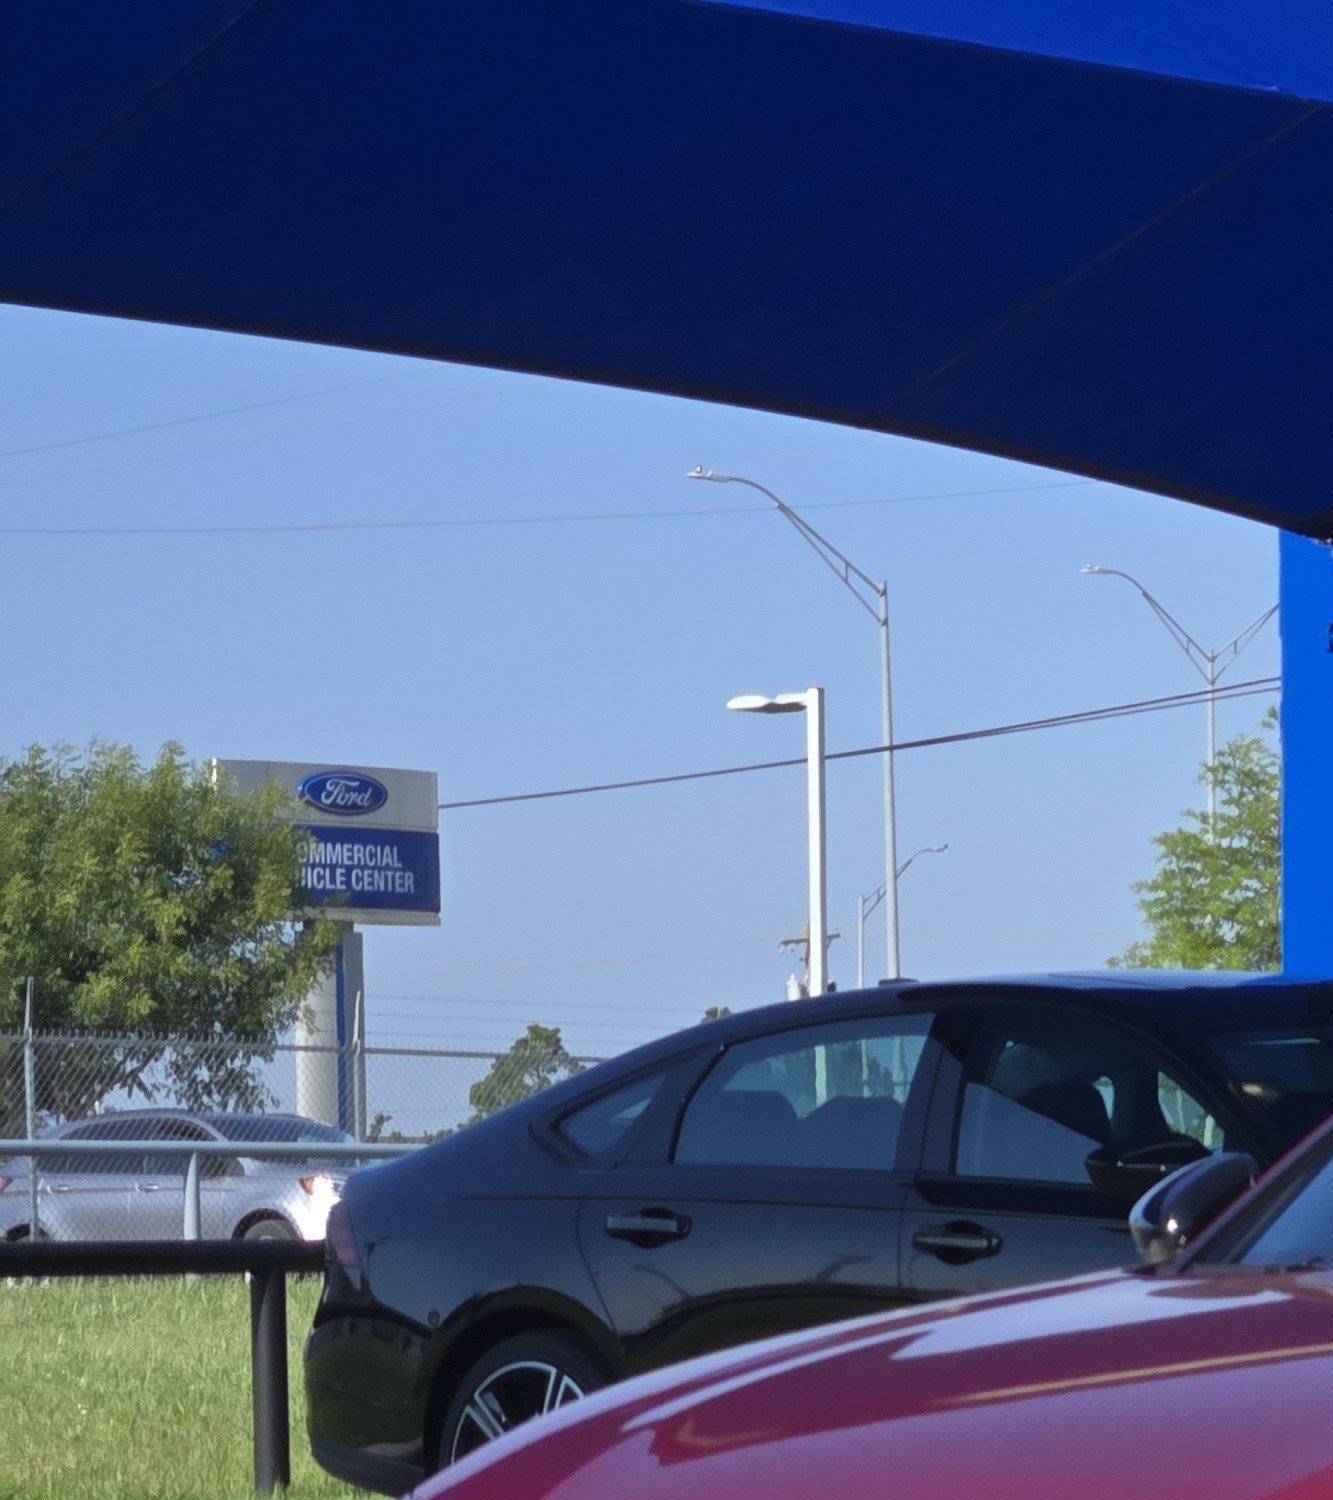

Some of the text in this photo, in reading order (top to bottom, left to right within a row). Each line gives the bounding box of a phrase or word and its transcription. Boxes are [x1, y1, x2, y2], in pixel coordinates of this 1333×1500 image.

[320, 778, 373, 807] Ford
[296, 841, 403, 868] OMMERCIAL
[351, 868, 415, 894] CENTER
